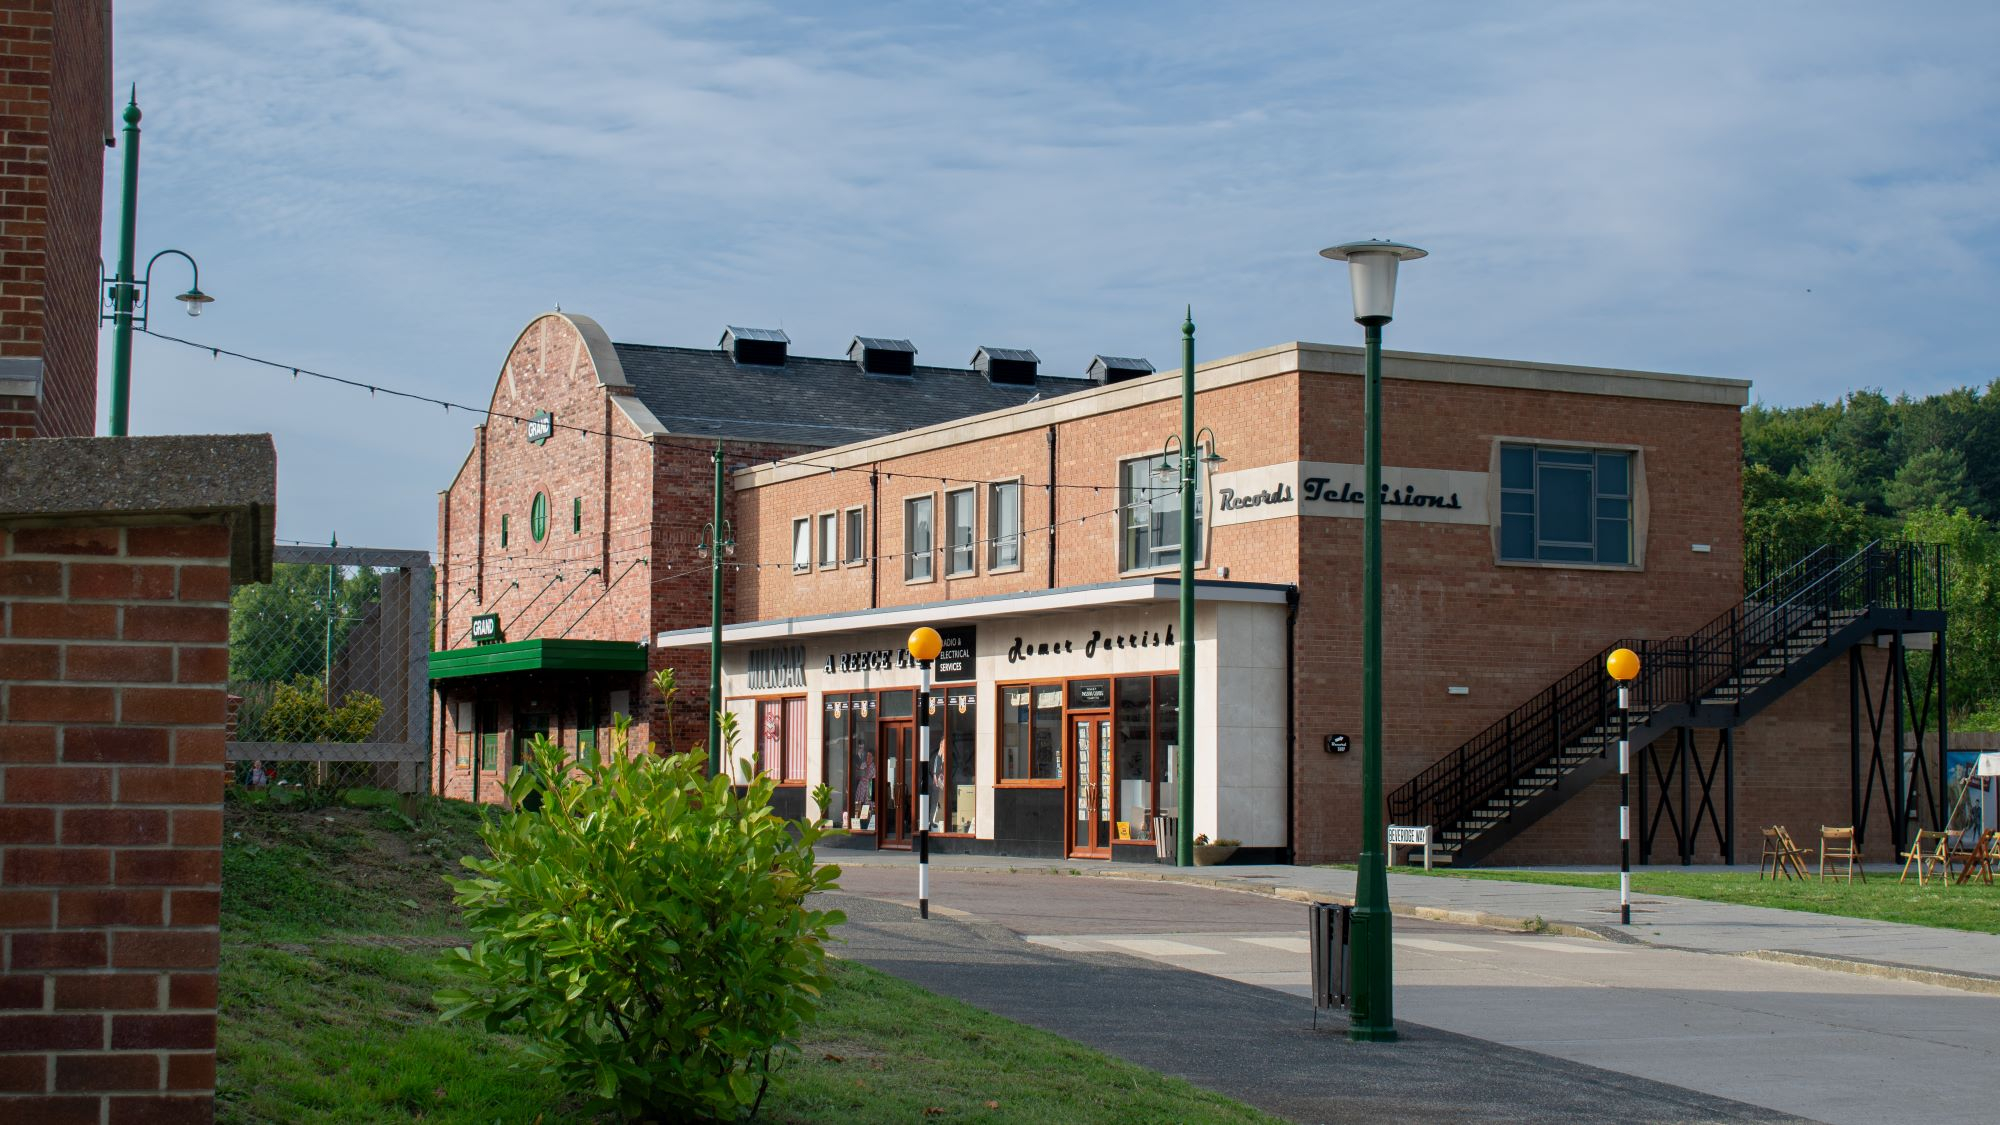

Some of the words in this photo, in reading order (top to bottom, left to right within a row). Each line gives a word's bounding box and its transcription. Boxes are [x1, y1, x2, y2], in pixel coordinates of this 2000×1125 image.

[528, 418, 549, 437] GRAND
[1219, 483, 1294, 511] Records
[1304, 477, 1462, 510] Teleisions
[473, 618, 494, 635] GRAND
[942, 638, 957, 647] ADIO
[1008, 637, 1073, 663] Romer
[1085, 624, 1175, 658] Parrish
[824, 655, 835, 673] A
[840, 649, 891, 672] REECE
[940, 649, 970, 659] ELECTRICAL
[940, 662, 962, 672] SERVICES
[1389, 829, 1415, 842] BEVERIDGE
[1416, 829, 1425, 843] WAY
